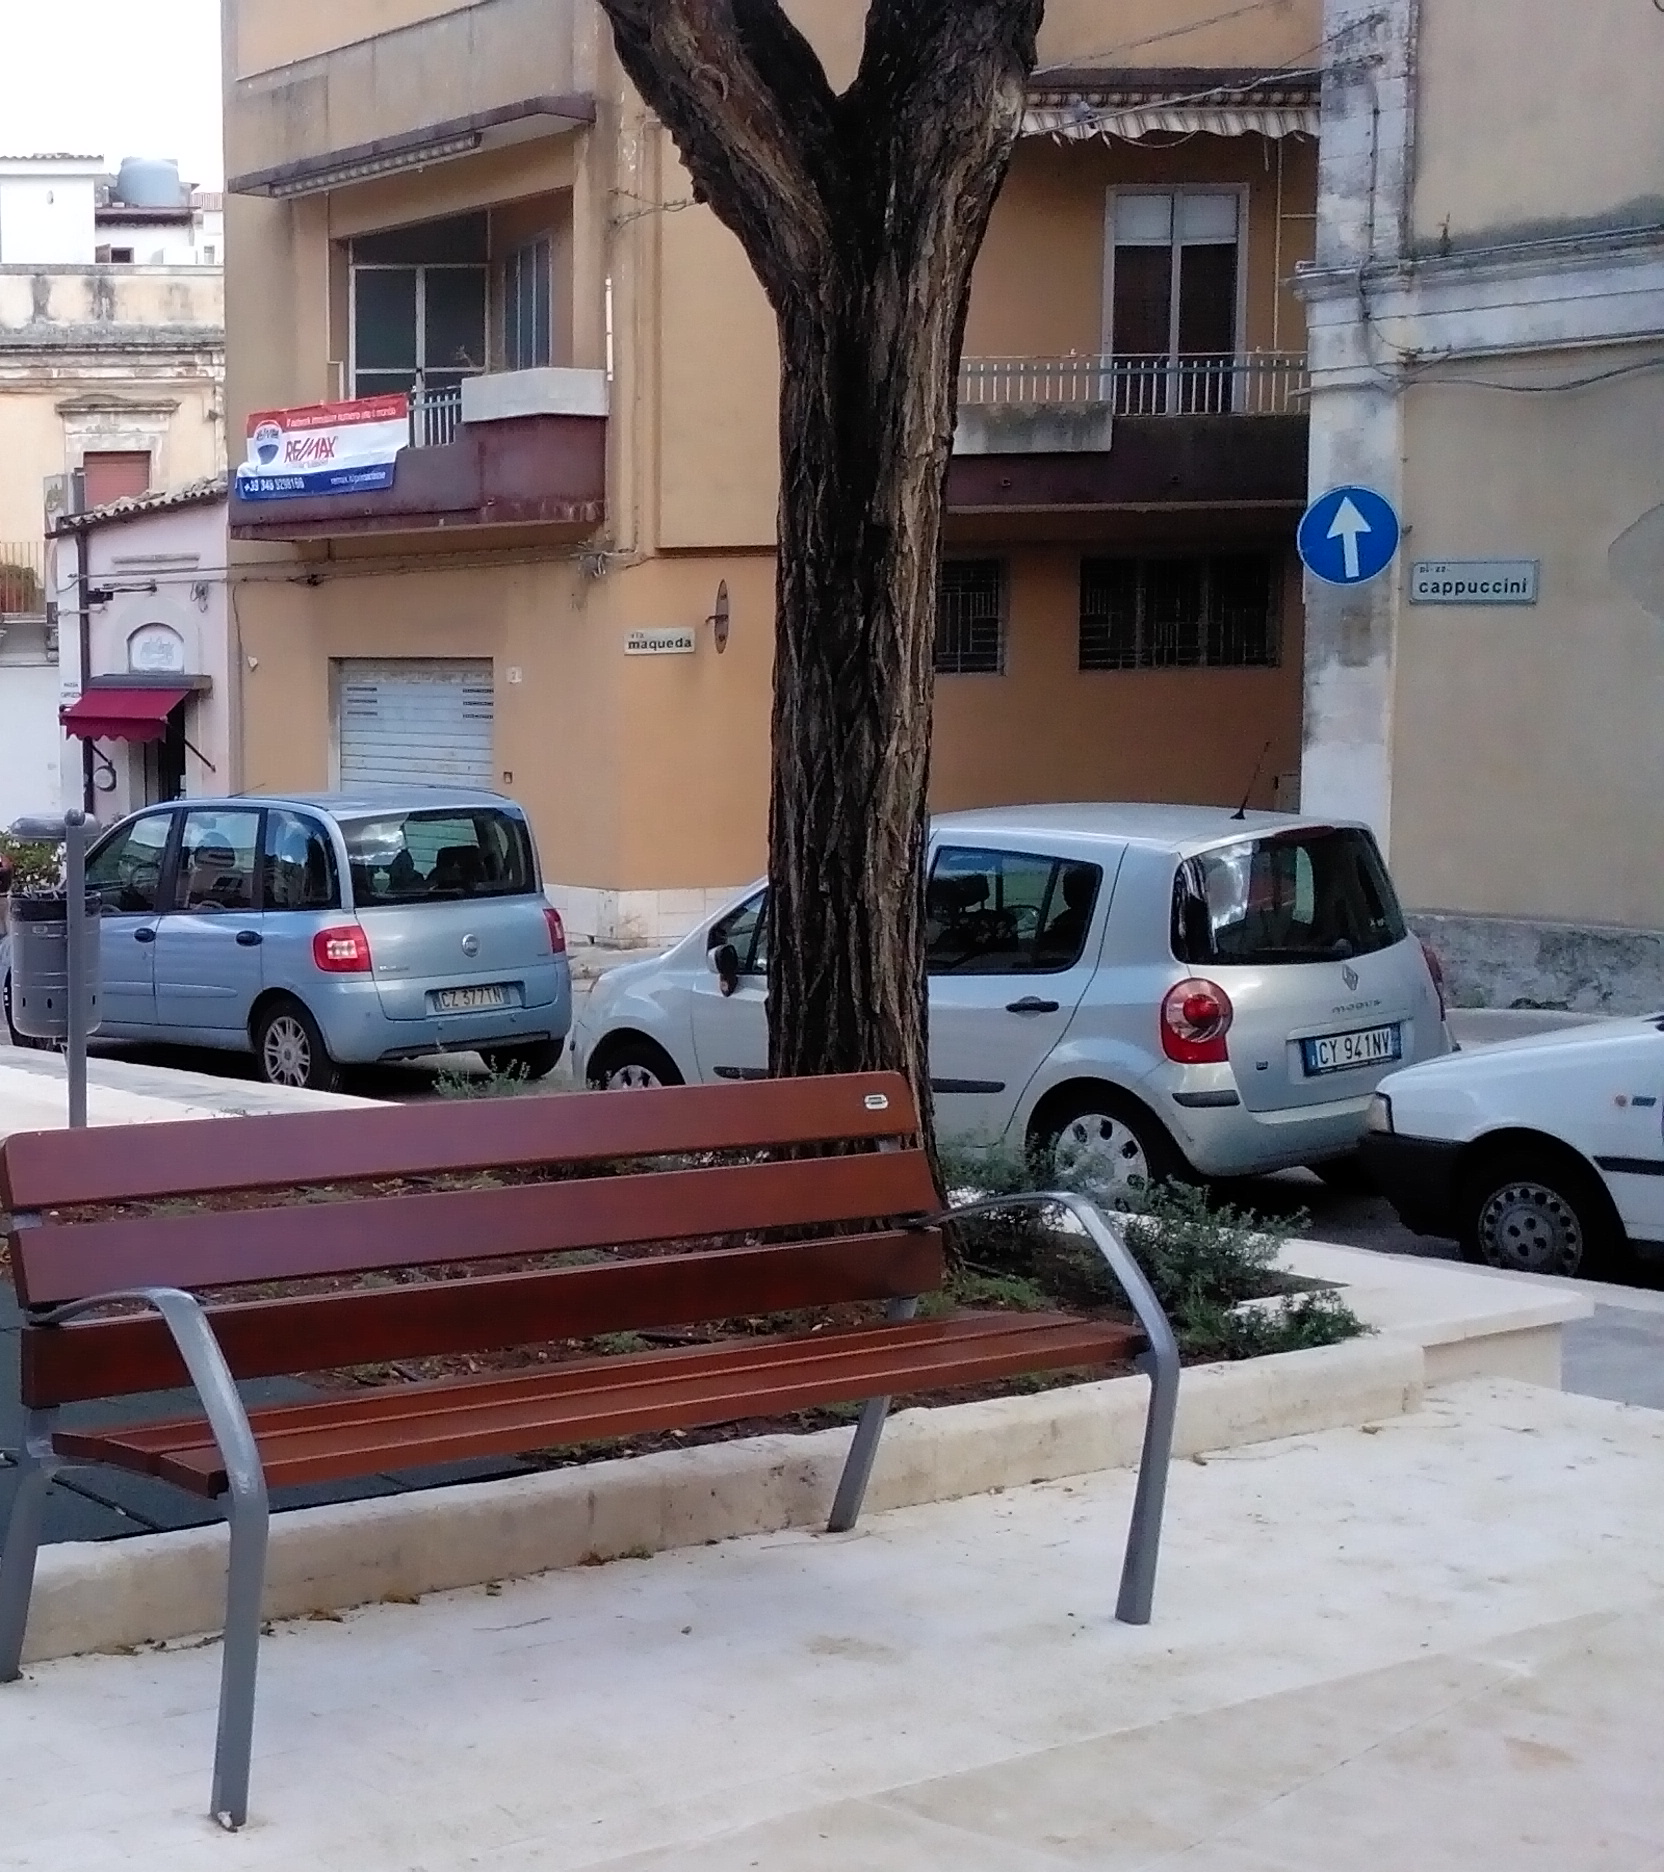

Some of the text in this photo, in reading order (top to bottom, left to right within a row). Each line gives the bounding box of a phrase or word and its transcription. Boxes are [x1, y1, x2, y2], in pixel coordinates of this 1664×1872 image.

[1419, 577, 1527, 596] cappuccini
[628, 637, 693, 651] maqueda
[441, 986, 503, 1008] CZ 377TN
[1318, 1039, 1338, 1065] CY
[1344, 1029, 1391, 1060] 941NV
